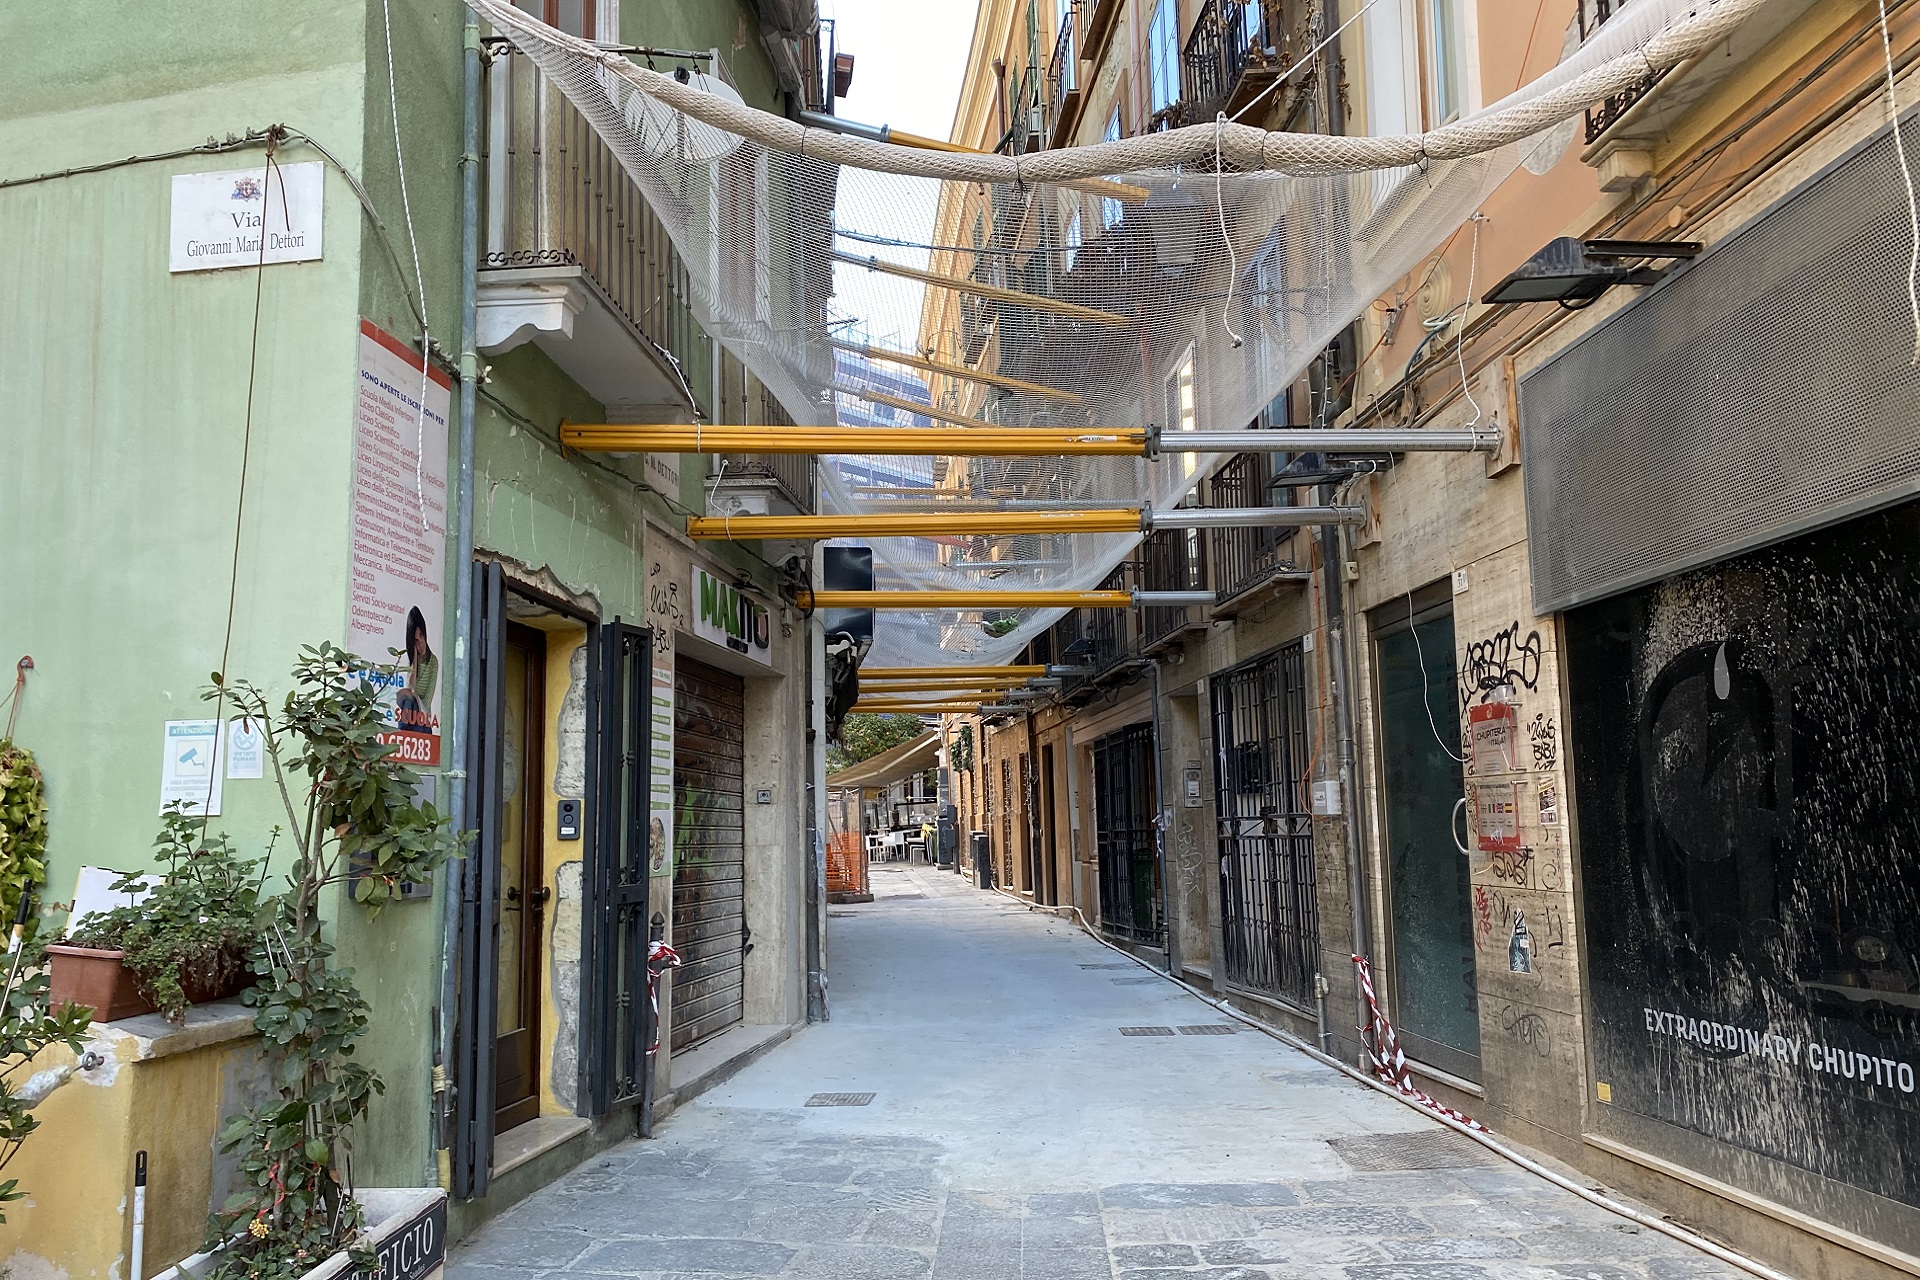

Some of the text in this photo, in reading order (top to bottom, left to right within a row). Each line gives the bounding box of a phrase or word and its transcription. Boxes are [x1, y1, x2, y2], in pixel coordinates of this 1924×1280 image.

[231, 212, 262, 228] Via
[187, 231, 304, 256] Giovanni Maria Dettori
[360, 385, 414, 424] Scuola Media Inferiore
[360, 398, 394, 424] Liceo Classico
[362, 370, 444, 426] SONO APERTE LE ISCRIIONI PER
[360, 409, 400, 439] Liceo Scientifico
[359, 422, 420, 462] Liceo Scientifico Sportivo
[358, 436, 372, 452] Liceo
[374, 444, 399, 464] Scientifico
[426, 472, 445, 490] Applicate
[358, 450, 400, 478] Liceo Linguistico
[357, 462, 372, 477] Liceo
[372, 470, 385, 484] delle
[386, 477, 404, 494] Scienze
[405, 486, 420, 500] Uman
[428, 498, 443, 512] Sociale
[357, 474, 371, 488] Liceo
[372, 483, 384, 496] delle
[386, 488, 404, 504] Scienze
[356, 502, 374, 517] Sistemi
[403, 522, 422, 538] Aziendali
[357, 488, 400, 516] Amministrazione,
[403, 508, 420, 524] Finanza
[356, 514, 386, 536] Costruzioni,
[387, 528, 410, 545] Ambiente
[415, 538, 434, 554] Territorio
[356, 527, 385, 546] Informatica
[390, 540, 432, 565] Telecomunicazioni
[353, 566, 374, 581] Nautico
[354, 540, 422, 574] Elettronica ed Elettrotecnica
[354, 552, 440, 592] Meccanica, Meccatronica ed Energia
[352, 590, 405, 614] Servizi Socio-sanitari
[353, 578, 376, 594] Turistico
[351, 618, 384, 635] Alberghiero
[352, 604, 392, 624] Odontotecnico
[701, 571, 769, 649] MAKITO
[386, 708, 440, 728] e SCUOLA
[1644, 1007, 1915, 1093] EXTRAORDINARY CHUPITO
